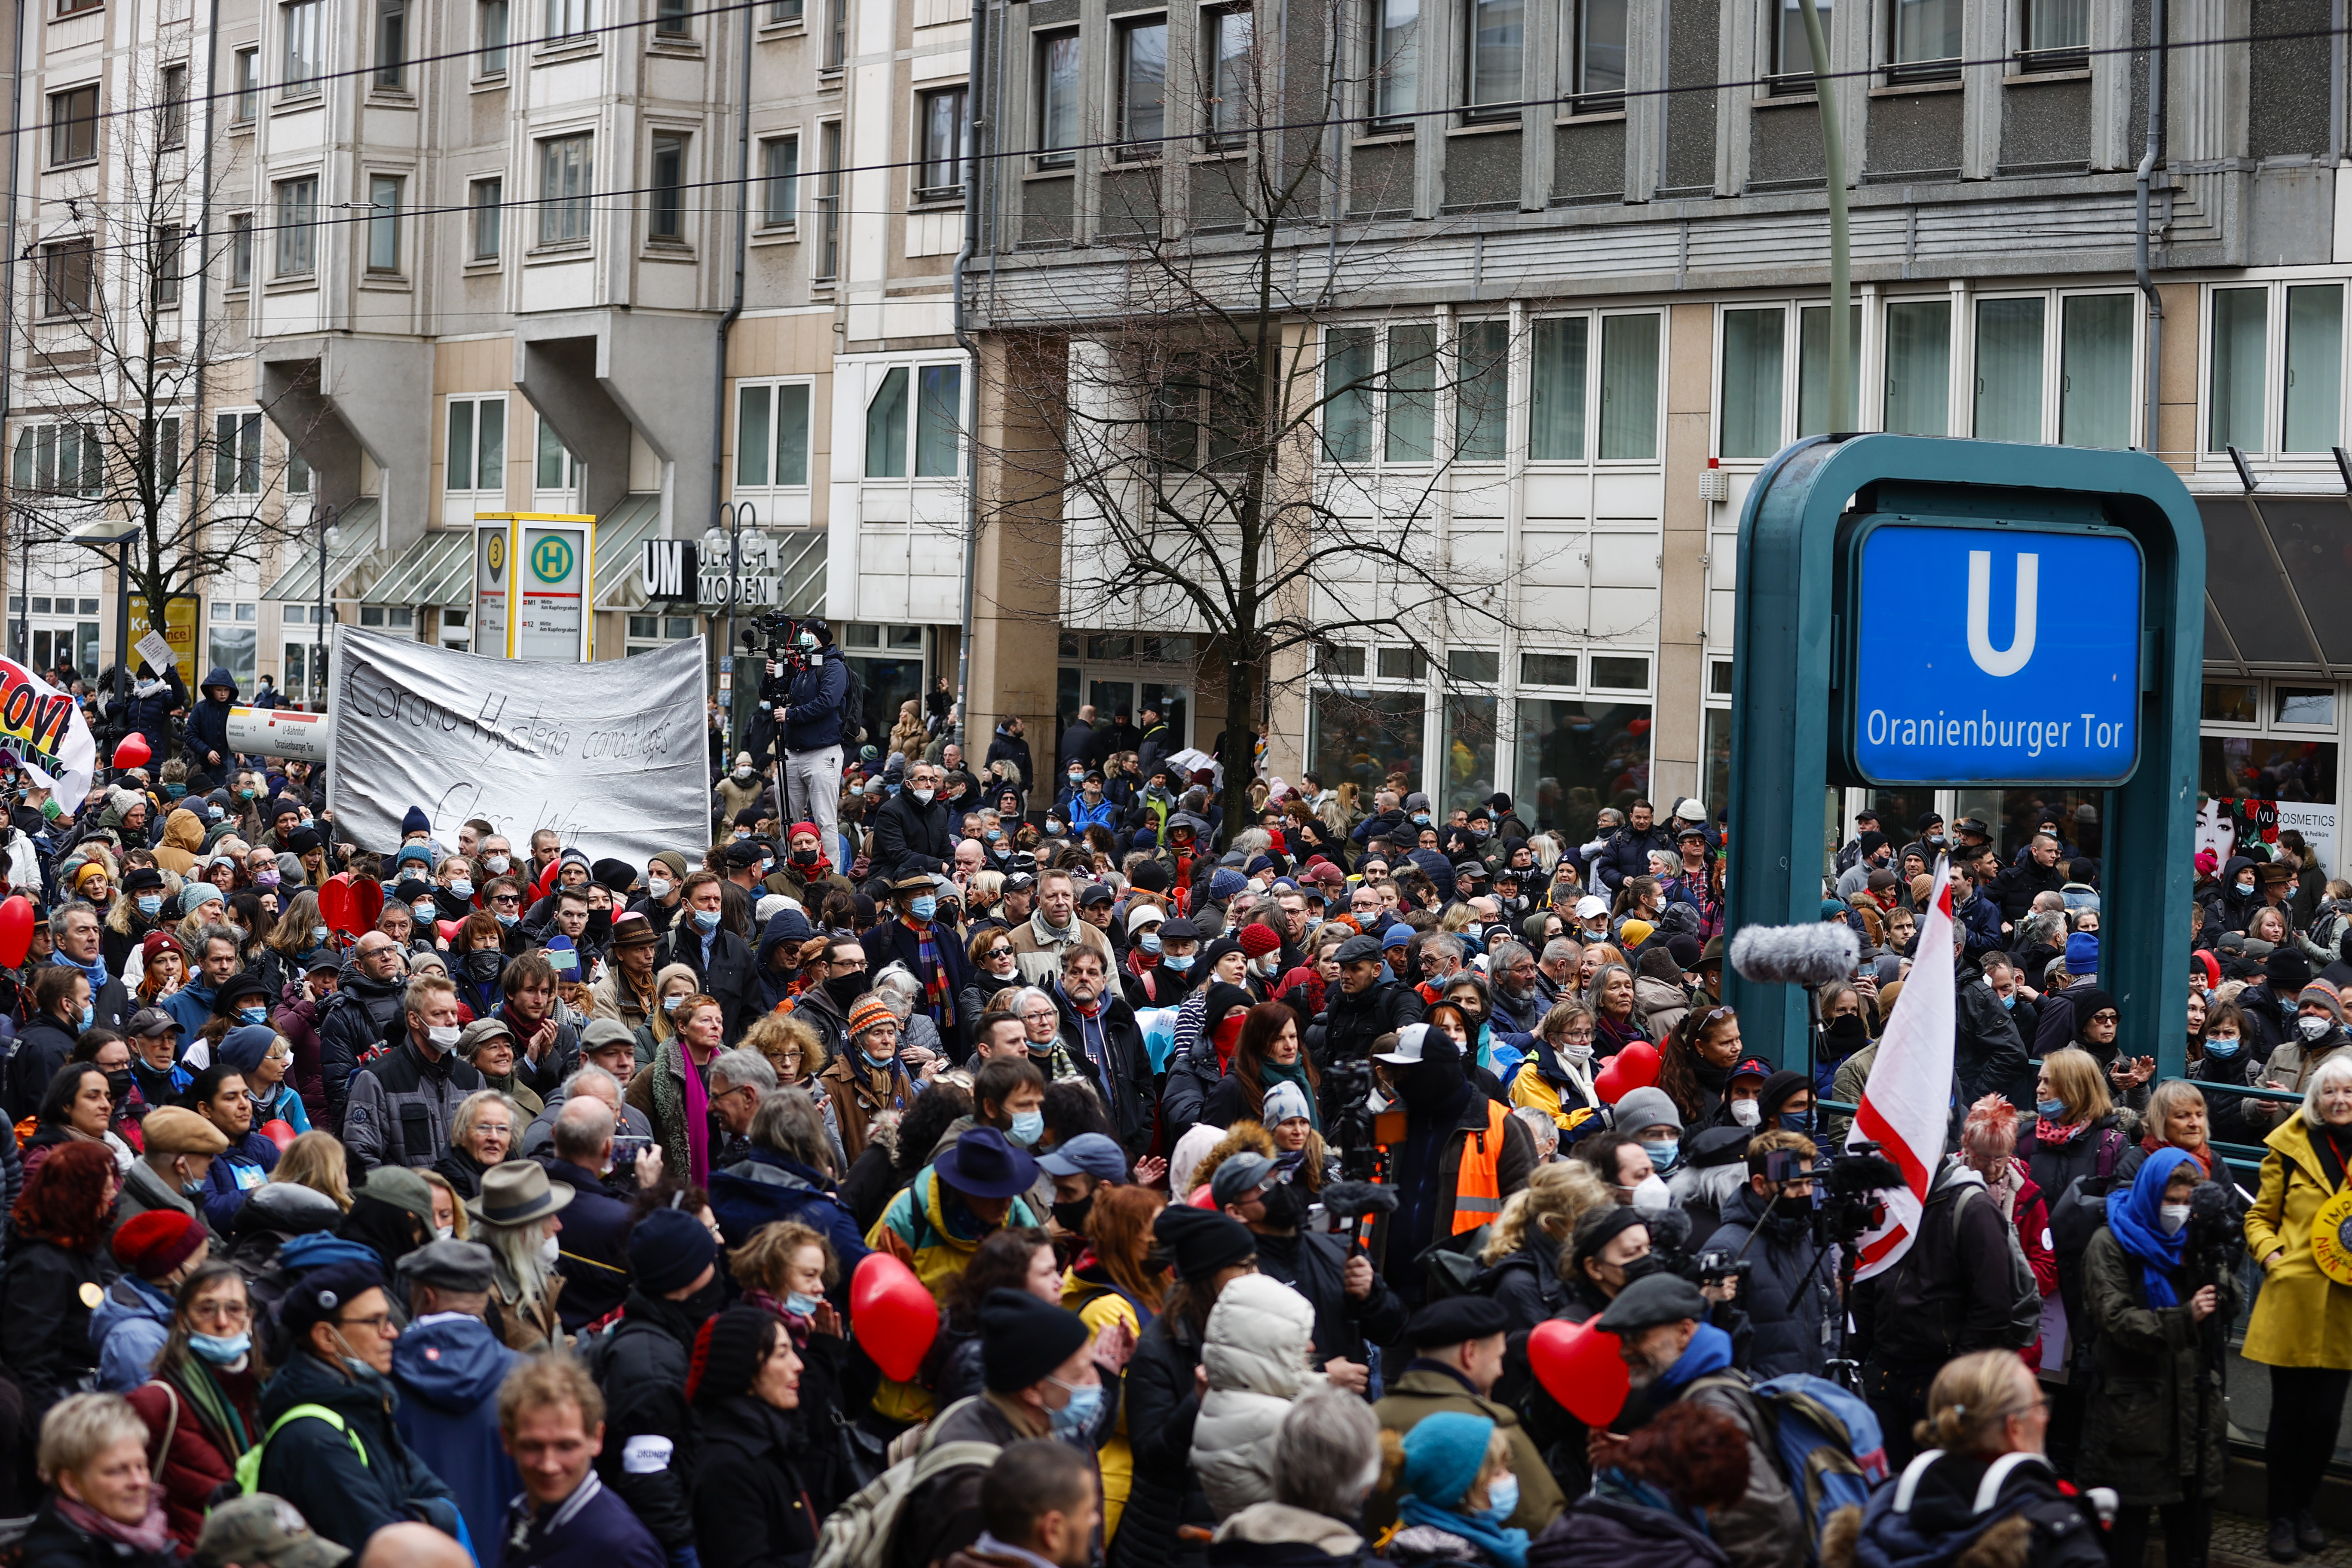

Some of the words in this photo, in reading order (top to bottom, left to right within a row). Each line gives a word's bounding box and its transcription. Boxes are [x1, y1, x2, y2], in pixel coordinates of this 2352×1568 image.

[493, 544, 499, 561] 3
[542, 546, 562, 573] H
[642, 540, 683, 596] UM
[1967, 550, 2038, 677] U
[282, 725, 306, 736] U-Bahnhof
[582, 713, 671, 771] camouflages
[1868, 709, 2071, 757] Oranienburger
[2081, 714, 2123, 747] Tor
[275, 739, 306, 753] Oranienburger
[2260, 812, 2273, 822] VU
[2276, 813, 2334, 826] COSMETICS
